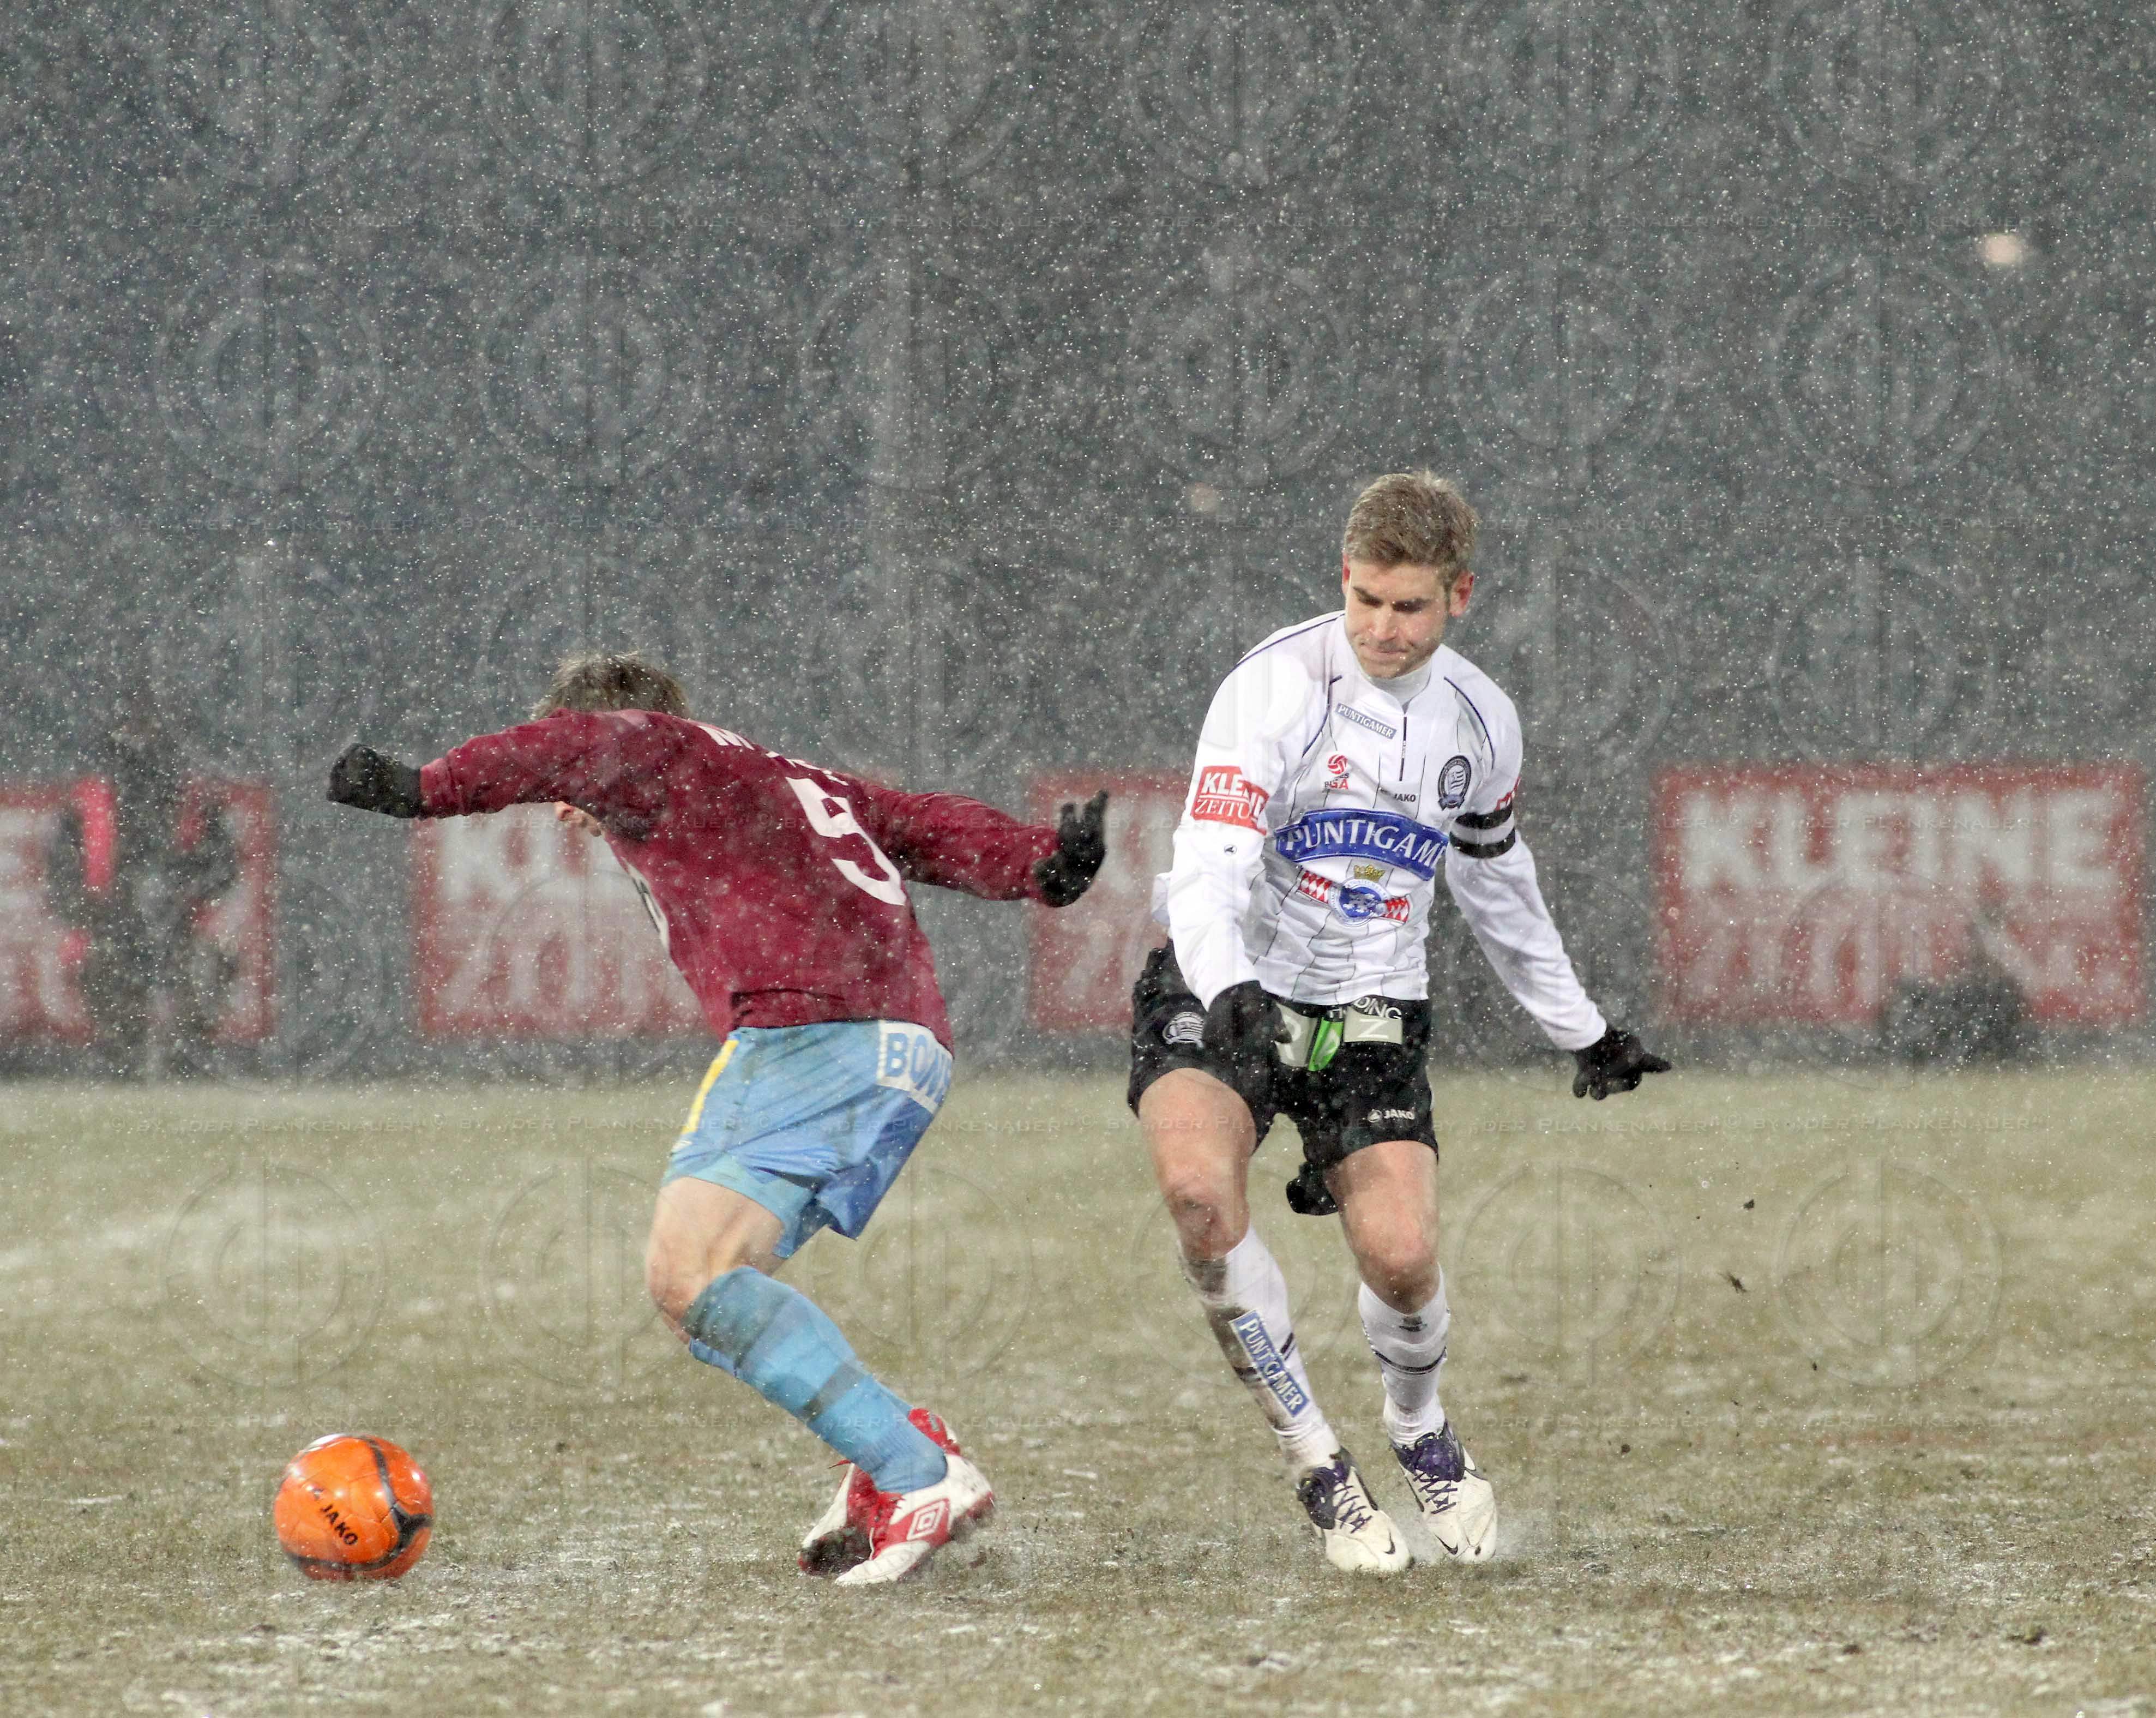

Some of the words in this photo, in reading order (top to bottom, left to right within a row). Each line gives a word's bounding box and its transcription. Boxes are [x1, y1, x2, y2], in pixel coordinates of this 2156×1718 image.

[1338, 705, 1393, 737] PUNTIGAMER
[1394, 793, 1417, 803] JAKO
[1683, 790, 2120, 889] KLEINE
[1383, 1109, 1415, 1120] JAKO
[320, 1504, 359, 1546] JAKO
